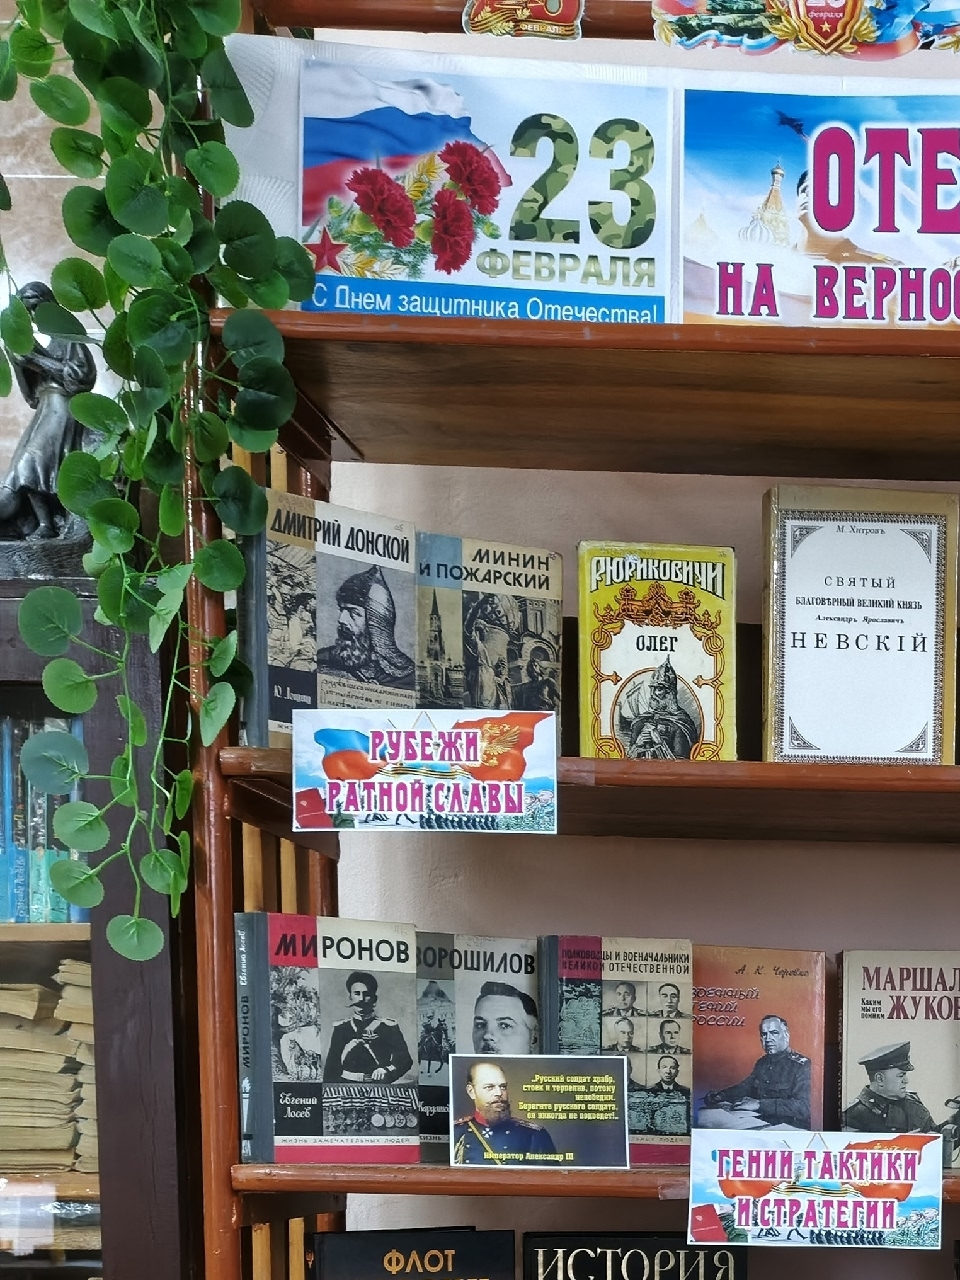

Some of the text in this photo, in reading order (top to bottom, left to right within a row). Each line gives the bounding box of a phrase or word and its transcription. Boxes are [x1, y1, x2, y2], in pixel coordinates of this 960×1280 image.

[509, 112, 657, 249] 23
[475, 248, 657, 288] ФЕВРАЛЯ
[312, 282, 328, 308] С
[334, 285, 392, 313] Днем
[397, 292, 521, 321] защитника
[715, 260, 779, 319] НА
[270, 507, 410, 564] ДМИТРИЙ ДОНСКОЙ
[472, 547, 550, 572] МИНИН
[419, 563, 550, 591] И ПОЖАРСКИЙ
[590, 556, 725, 600] РЮРИКОВИЧИ
[824, 574, 896, 590] СВЯТЫЙ
[857, 596, 895, 610] ВЕЛИКИЙ
[897, 600, 923, 611] КНЯЗЬ
[635, 633, 678, 653] ОЛЕГ
[369, 730, 480, 762] РУБЕЖИ
[326, 779, 524, 814] РАТНОЙ СЛАВЫ
[274, 933, 410, 964] МИРОНОВ
[861, 997, 882, 1006] Каким
[716, 1148, 920, 1182] ГЕНИИ ТАКТИКИ
[736, 1197, 897, 1230] И СТРАТЕГИИ
[383, 1249, 455, 1275] ФЛОТ
